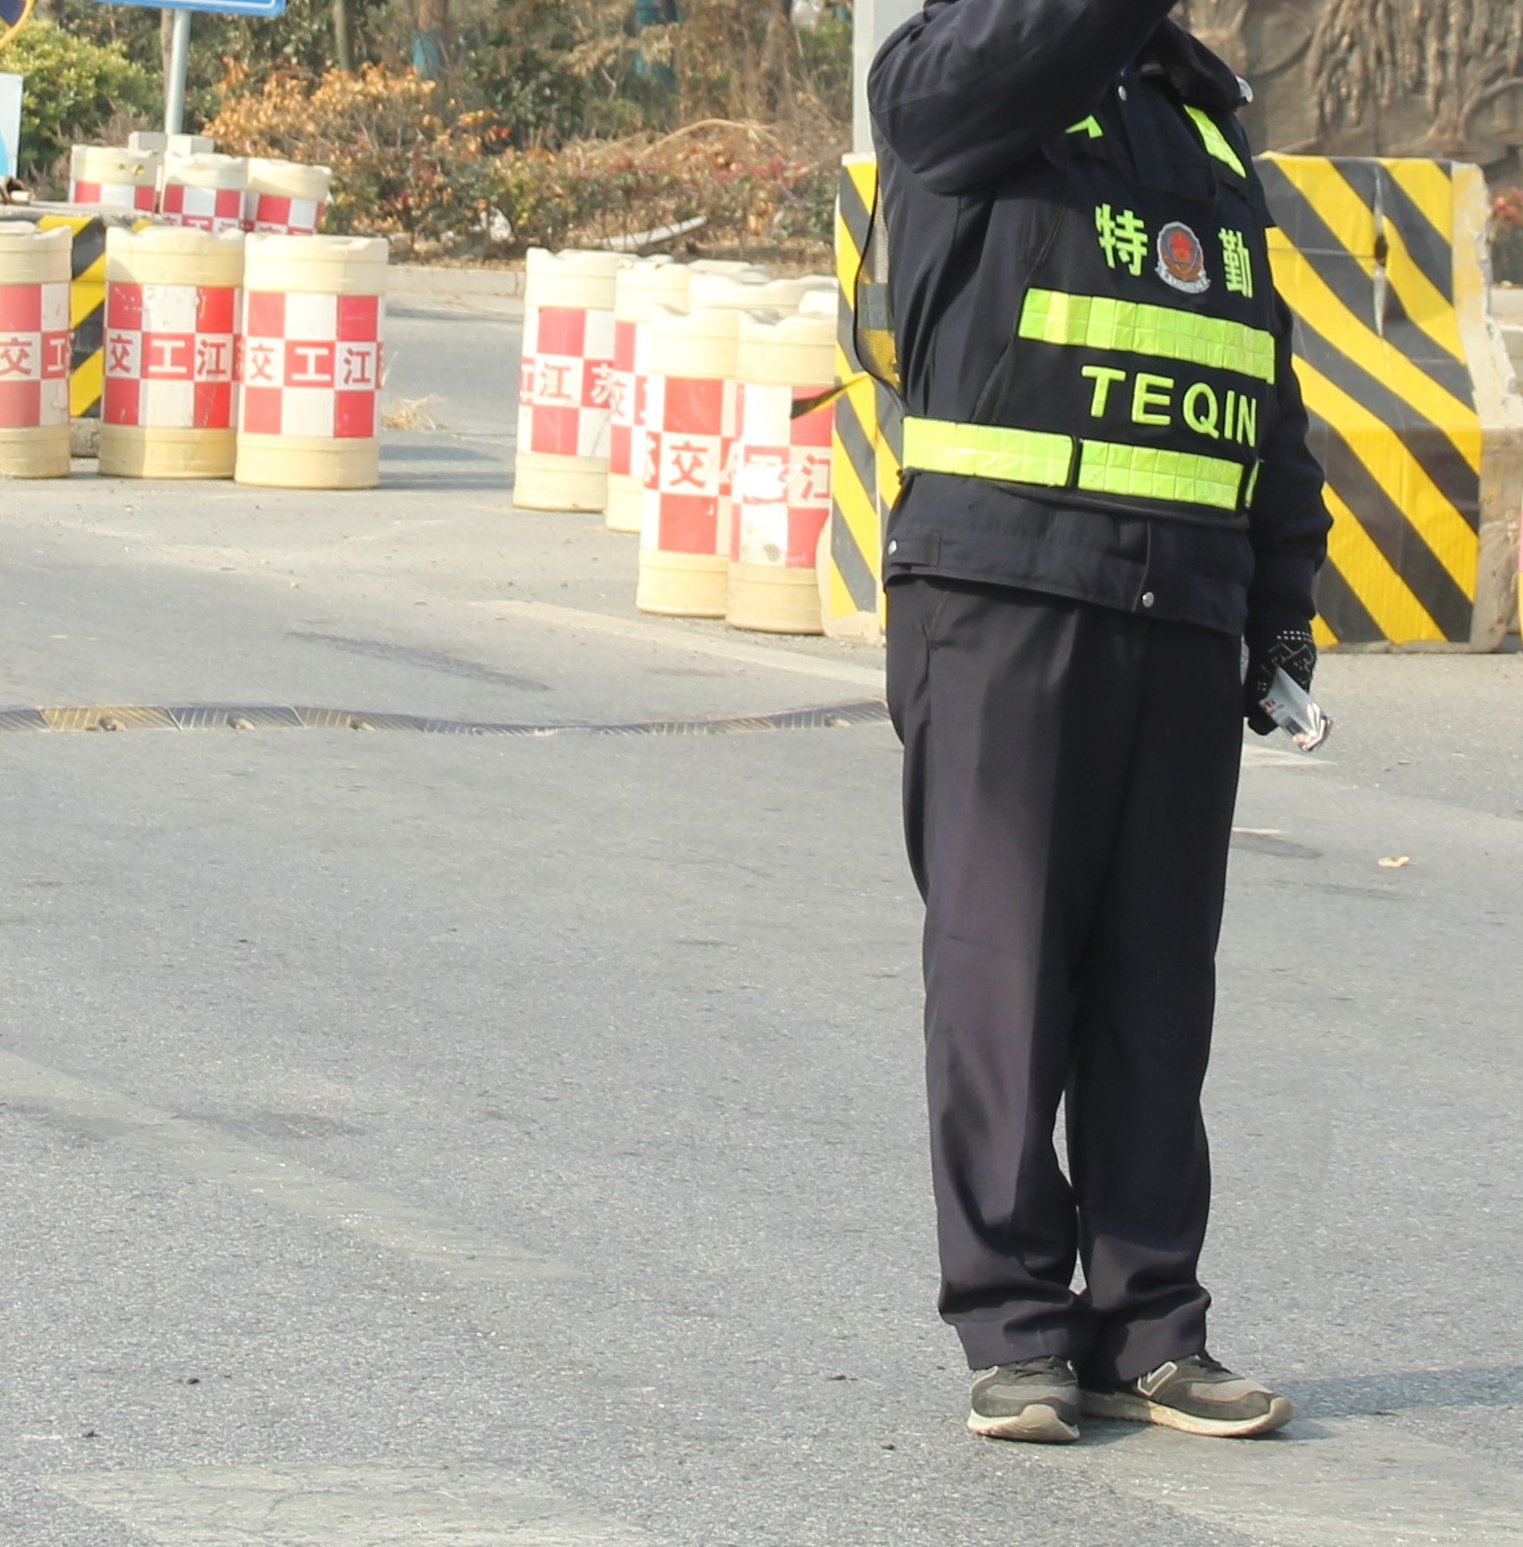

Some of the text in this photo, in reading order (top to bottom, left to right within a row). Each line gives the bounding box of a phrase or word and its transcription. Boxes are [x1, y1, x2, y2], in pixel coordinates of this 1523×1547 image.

[109, 334, 240, 376] 交工江
[250, 342, 382, 385] 交工江
[1081, 365, 1257, 447] TEQIN
